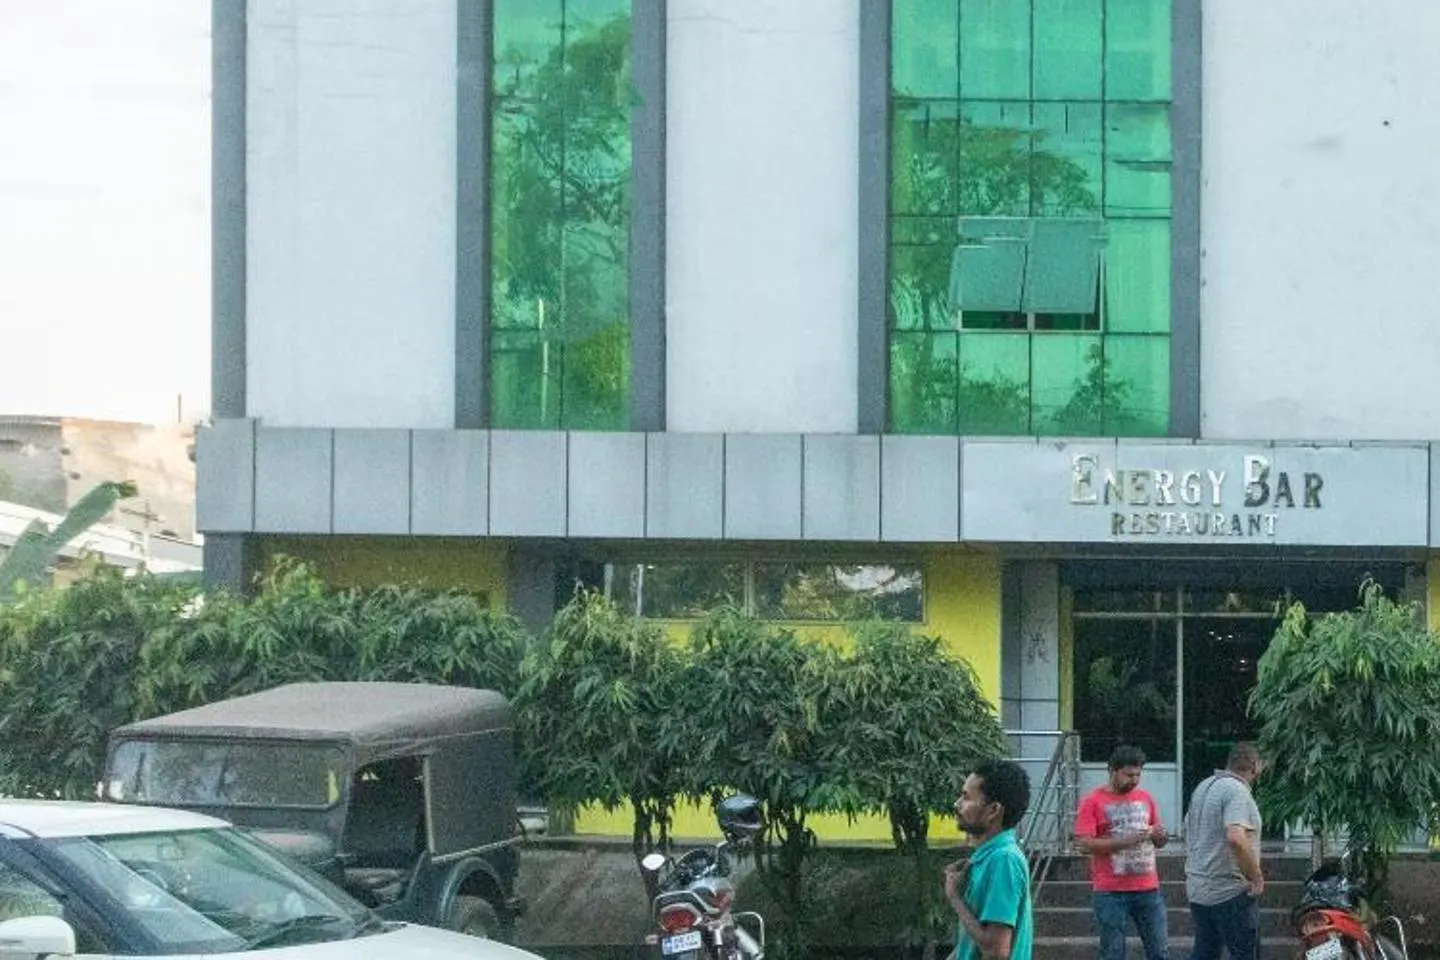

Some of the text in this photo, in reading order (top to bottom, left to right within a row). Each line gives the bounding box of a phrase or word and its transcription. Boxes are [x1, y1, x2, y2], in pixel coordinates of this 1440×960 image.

[1069, 452, 1324, 509] ENERGY BAR
[1111, 512, 1278, 537] RESTAURANT
